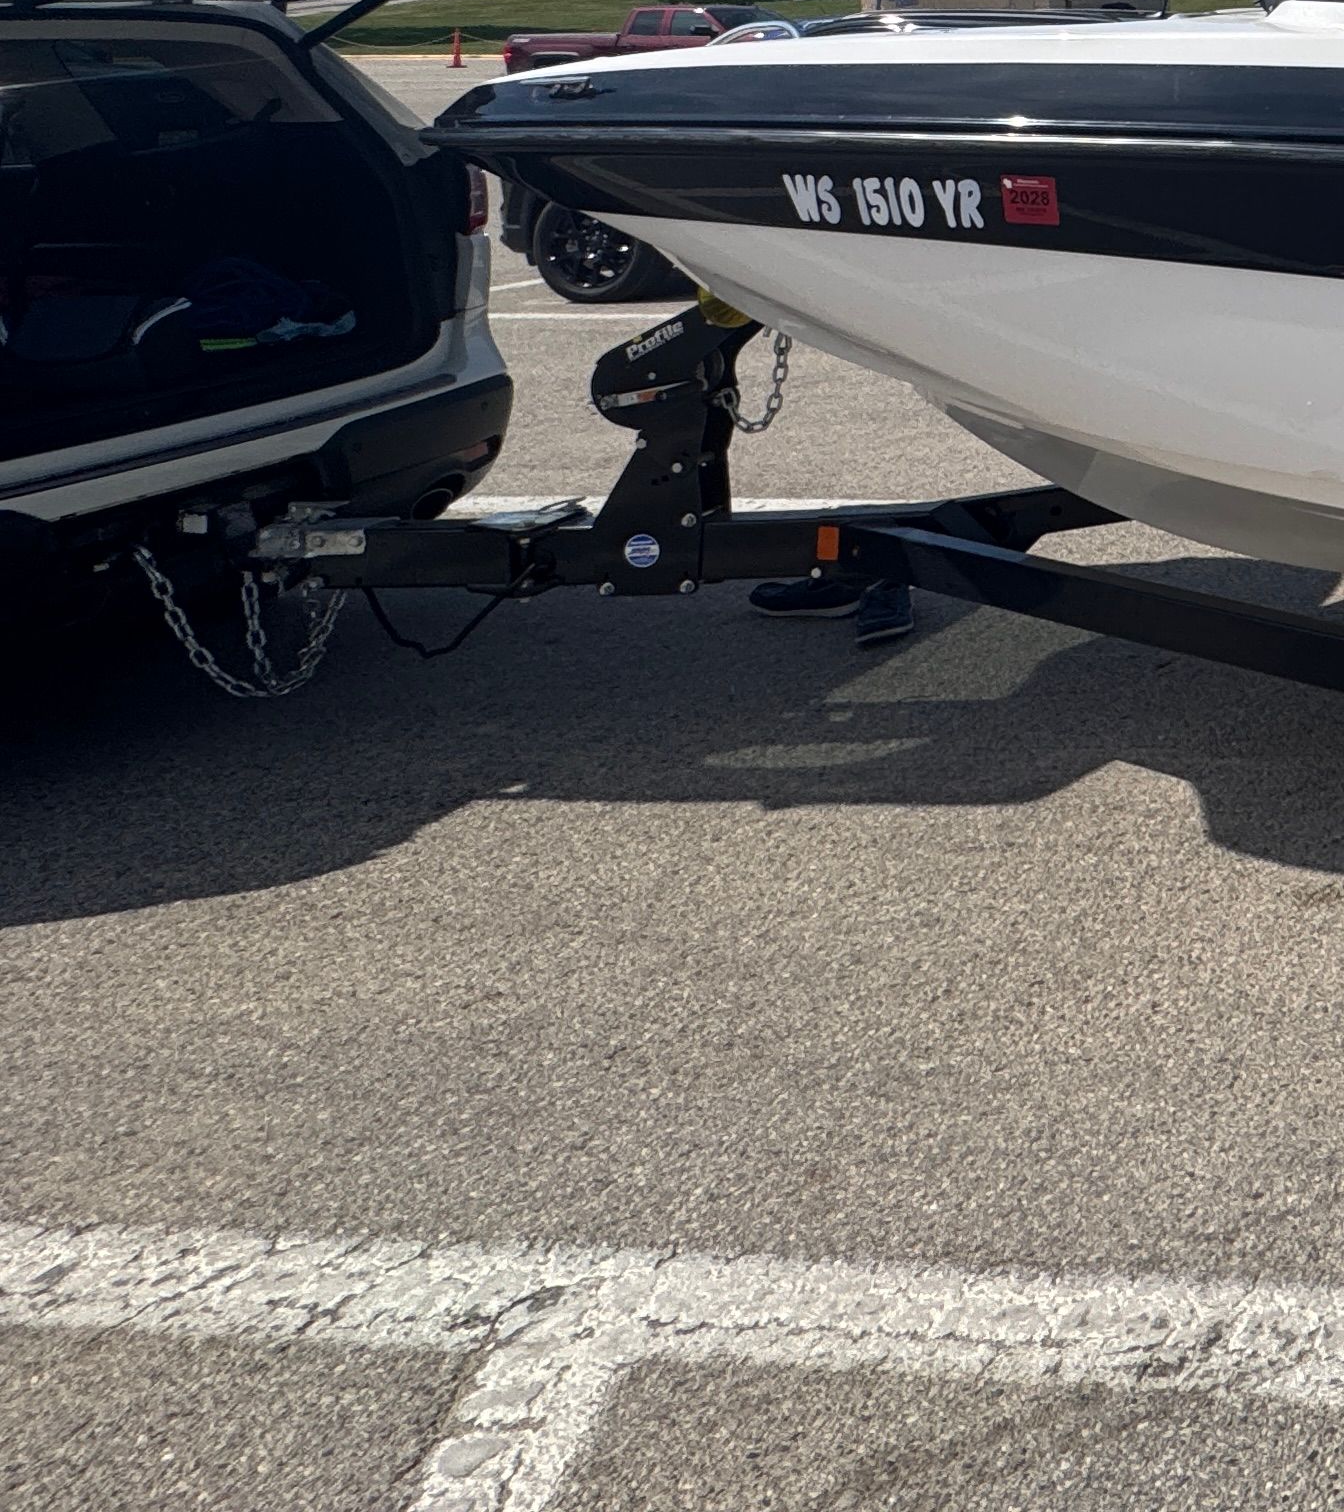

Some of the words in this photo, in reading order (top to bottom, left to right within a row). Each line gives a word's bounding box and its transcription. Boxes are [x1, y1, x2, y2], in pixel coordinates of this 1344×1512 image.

[782, 174, 841, 225] WS
[853, 177, 925, 228] 1510
[933, 178, 985, 229] YR
[1010, 189, 1050, 206] 2028
[626, 321, 684, 362] Profile
